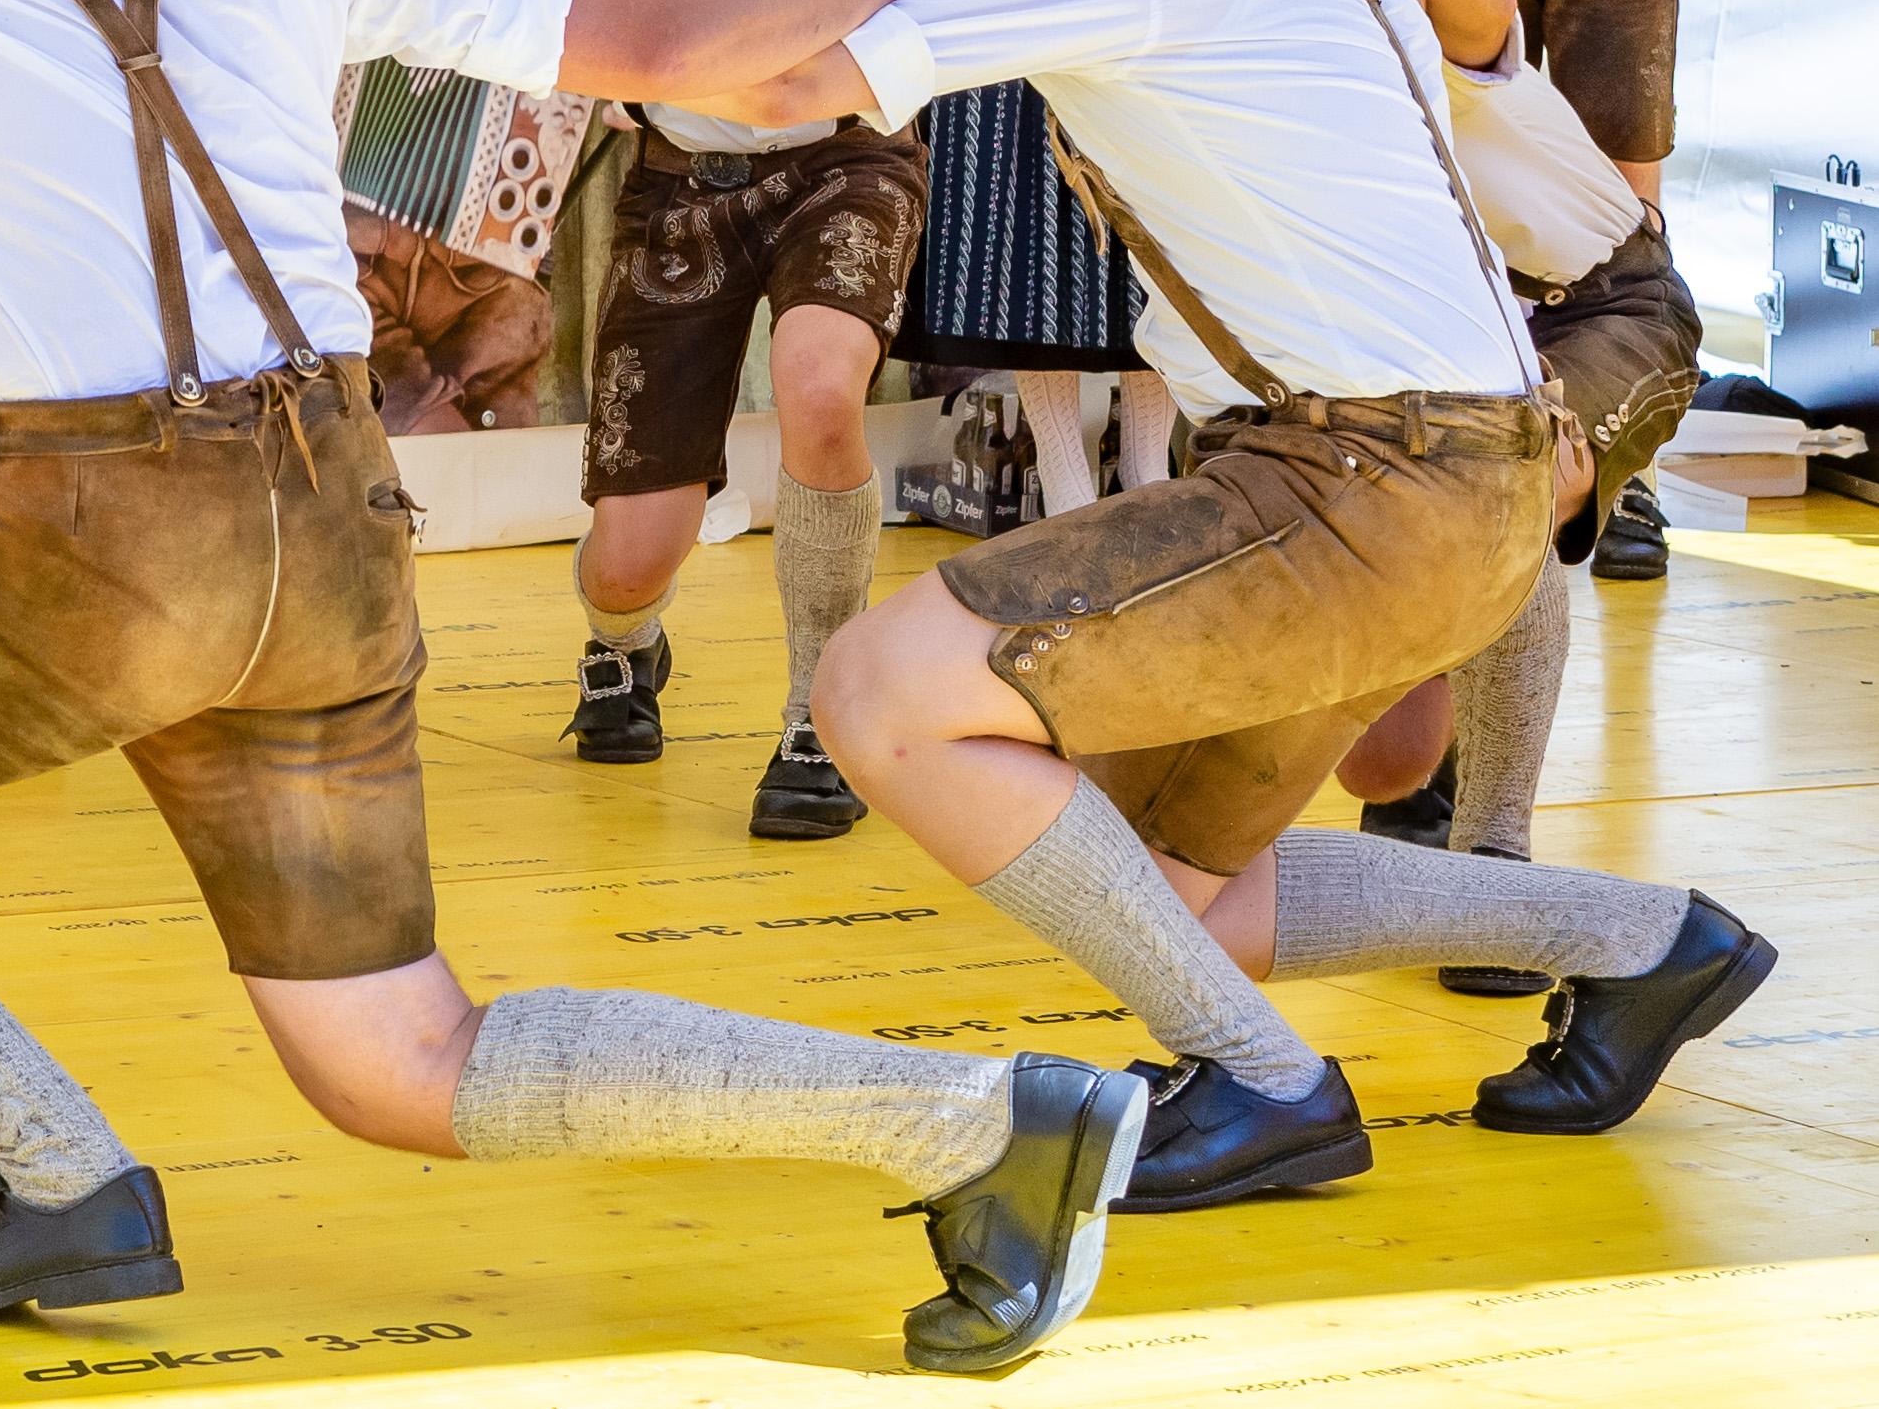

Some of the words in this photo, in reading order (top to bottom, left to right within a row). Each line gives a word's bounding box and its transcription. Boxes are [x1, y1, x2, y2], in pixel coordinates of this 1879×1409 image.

[954, 498, 984, 520] Zipfer
[755, 908, 940, 929] doka
[614, 924, 743, 944] 3-SO
[872, 1020, 1009, 1041] 3-SO
[162, 1155, 300, 1173] KAISERER
[1673, 1264, 1786, 1283] 04/2024
[22, 1345, 285, 1382] doka
[304, 1321, 474, 1353] 3-SO
[1083, 1333, 1210, 1353] 04/2024
[1429, 1347, 1571, 1371] KAISERER
[1223, 1373, 1352, 1395] 04/2024
